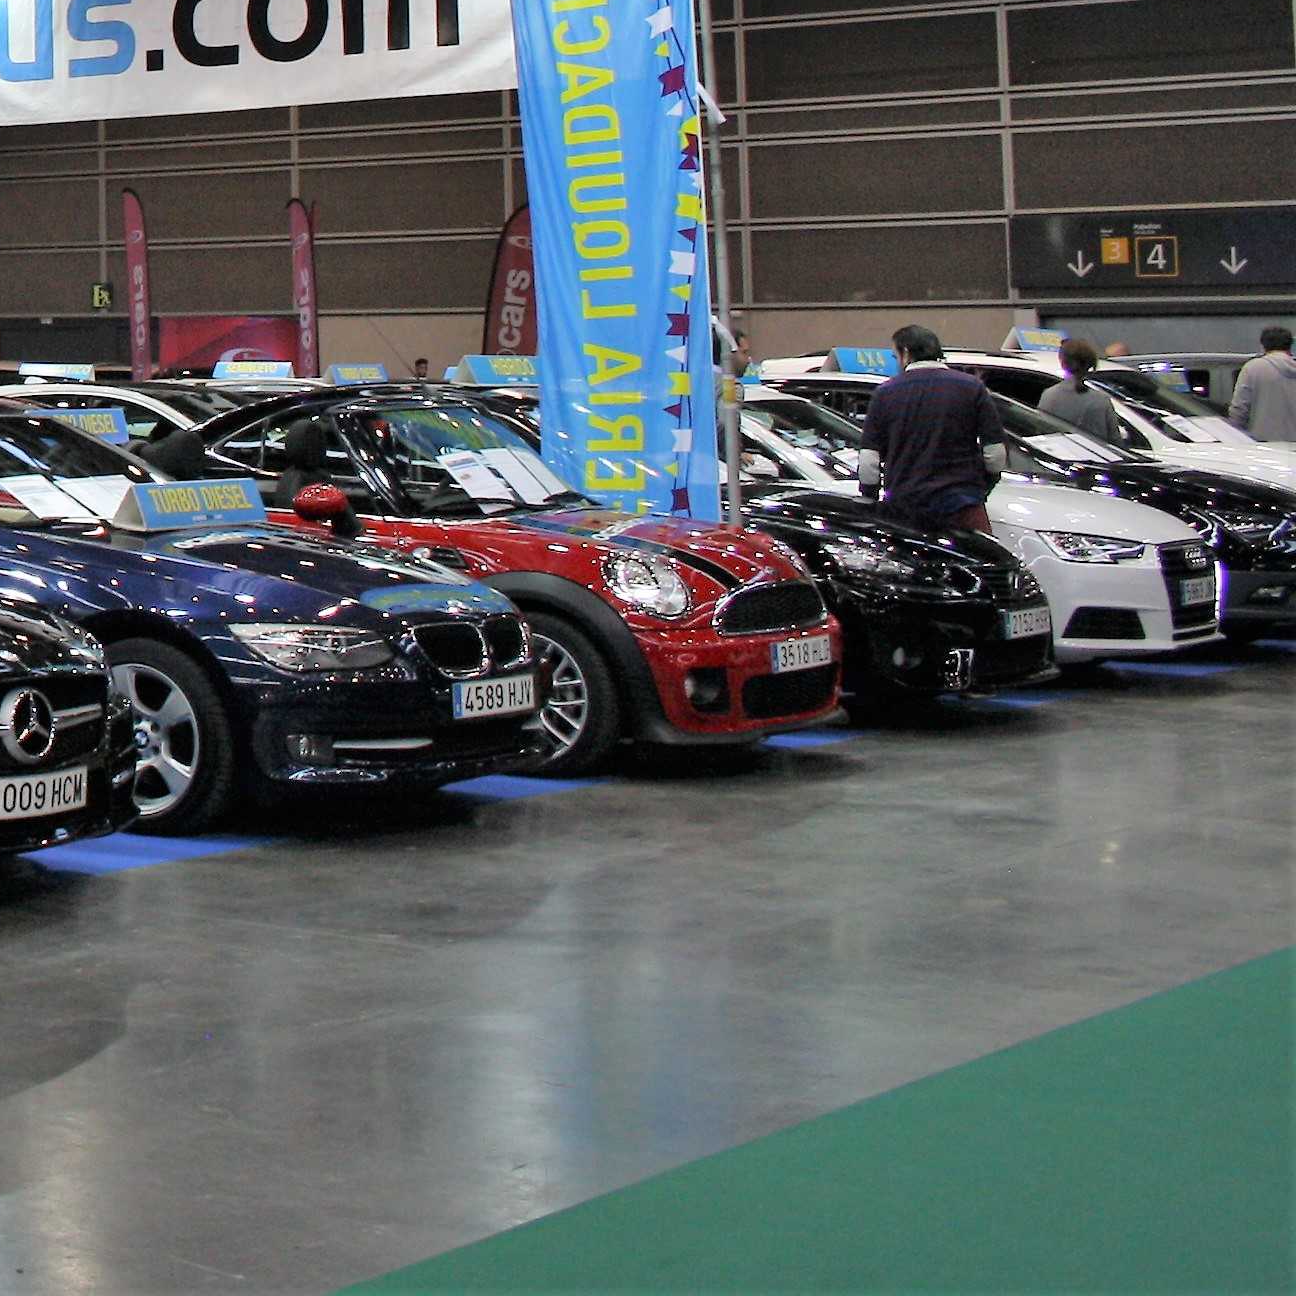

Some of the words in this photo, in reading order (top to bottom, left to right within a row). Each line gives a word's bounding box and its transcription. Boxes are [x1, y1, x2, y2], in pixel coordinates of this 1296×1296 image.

[1109, 242, 1121, 259] 3
[1147, 244, 1167, 269] 4
[148, 488, 198, 514] TURBO
[201, 484, 254, 510] DIESEL
[465, 684, 504, 712] 4589
[509, 680, 532, 707] HJV
